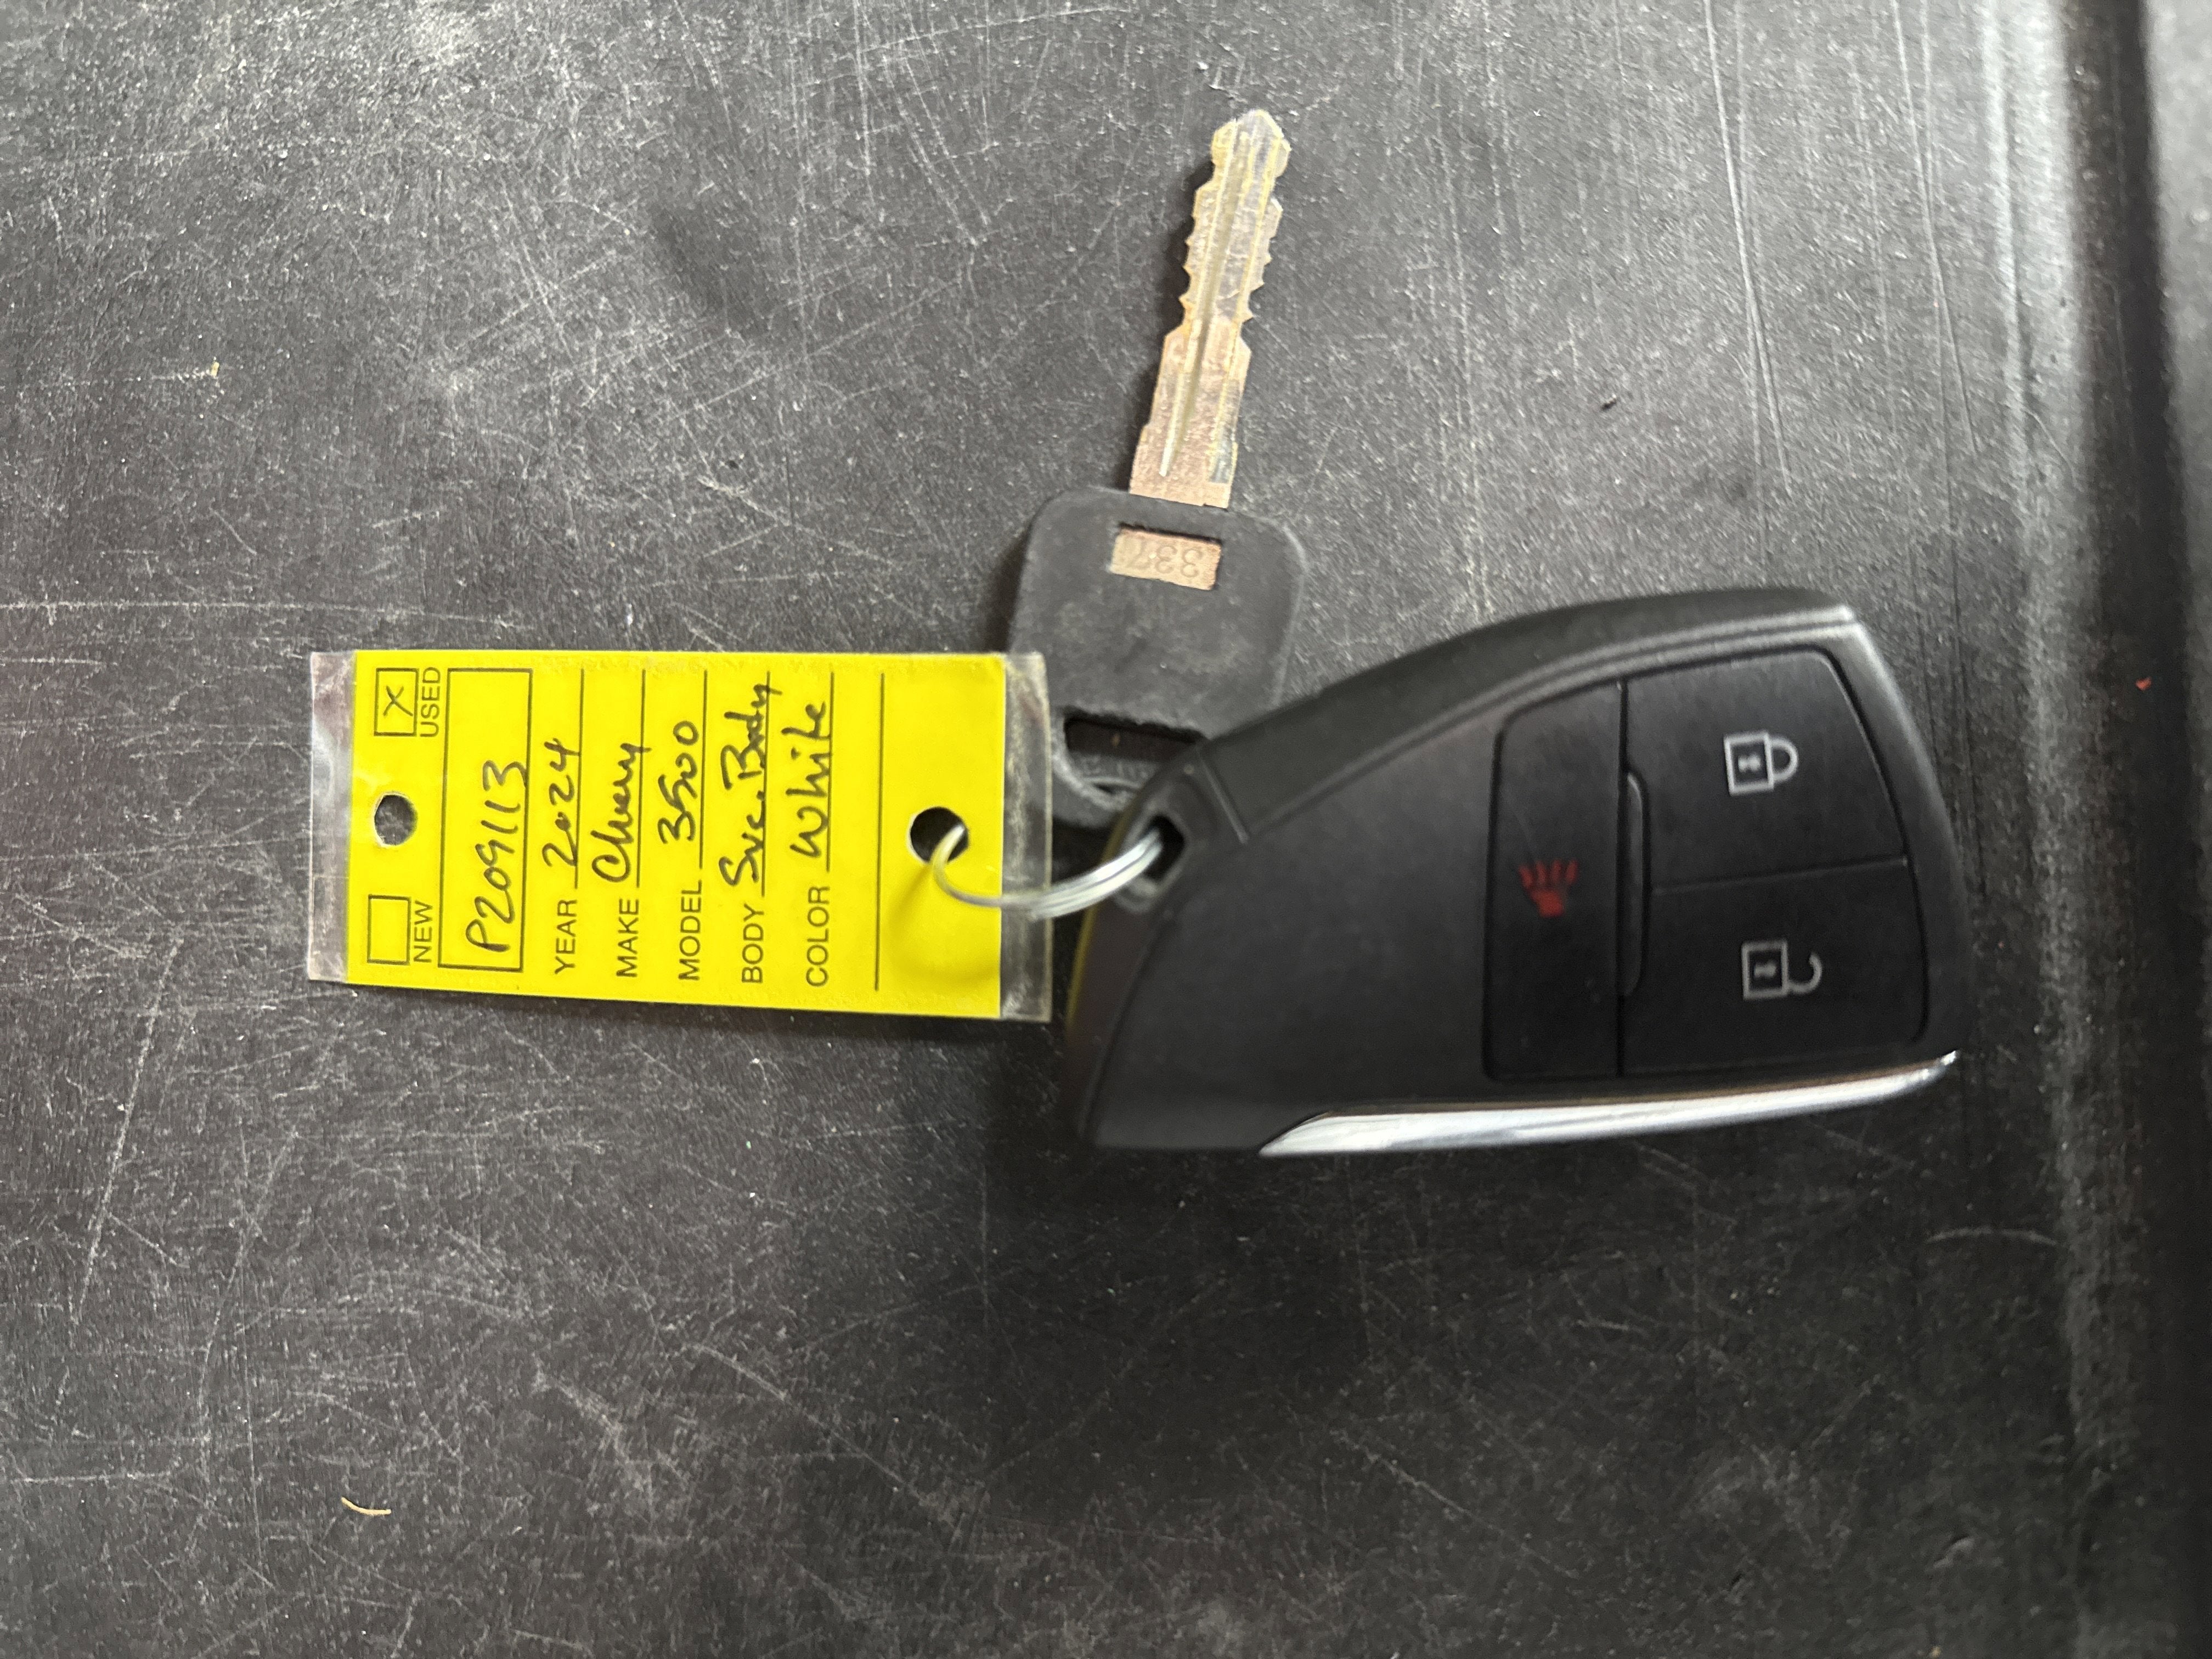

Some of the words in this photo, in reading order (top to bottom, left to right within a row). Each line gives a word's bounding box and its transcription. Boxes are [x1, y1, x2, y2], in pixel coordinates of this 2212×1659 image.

[420, 665, 441, 737] USED
[542, 738, 580, 867] 2024
[658, 720, 699, 844] 3500
[781, 702, 831, 858] White
[465, 760, 528, 952] P209113
[414, 900, 433, 963] NEW
[555, 899, 578, 974] YEAR
[617, 898, 640, 978] MAKE
[678, 879, 703, 981] MODEL
[742, 904, 765, 984] BODY
[806, 885, 830, 987] COLOR
